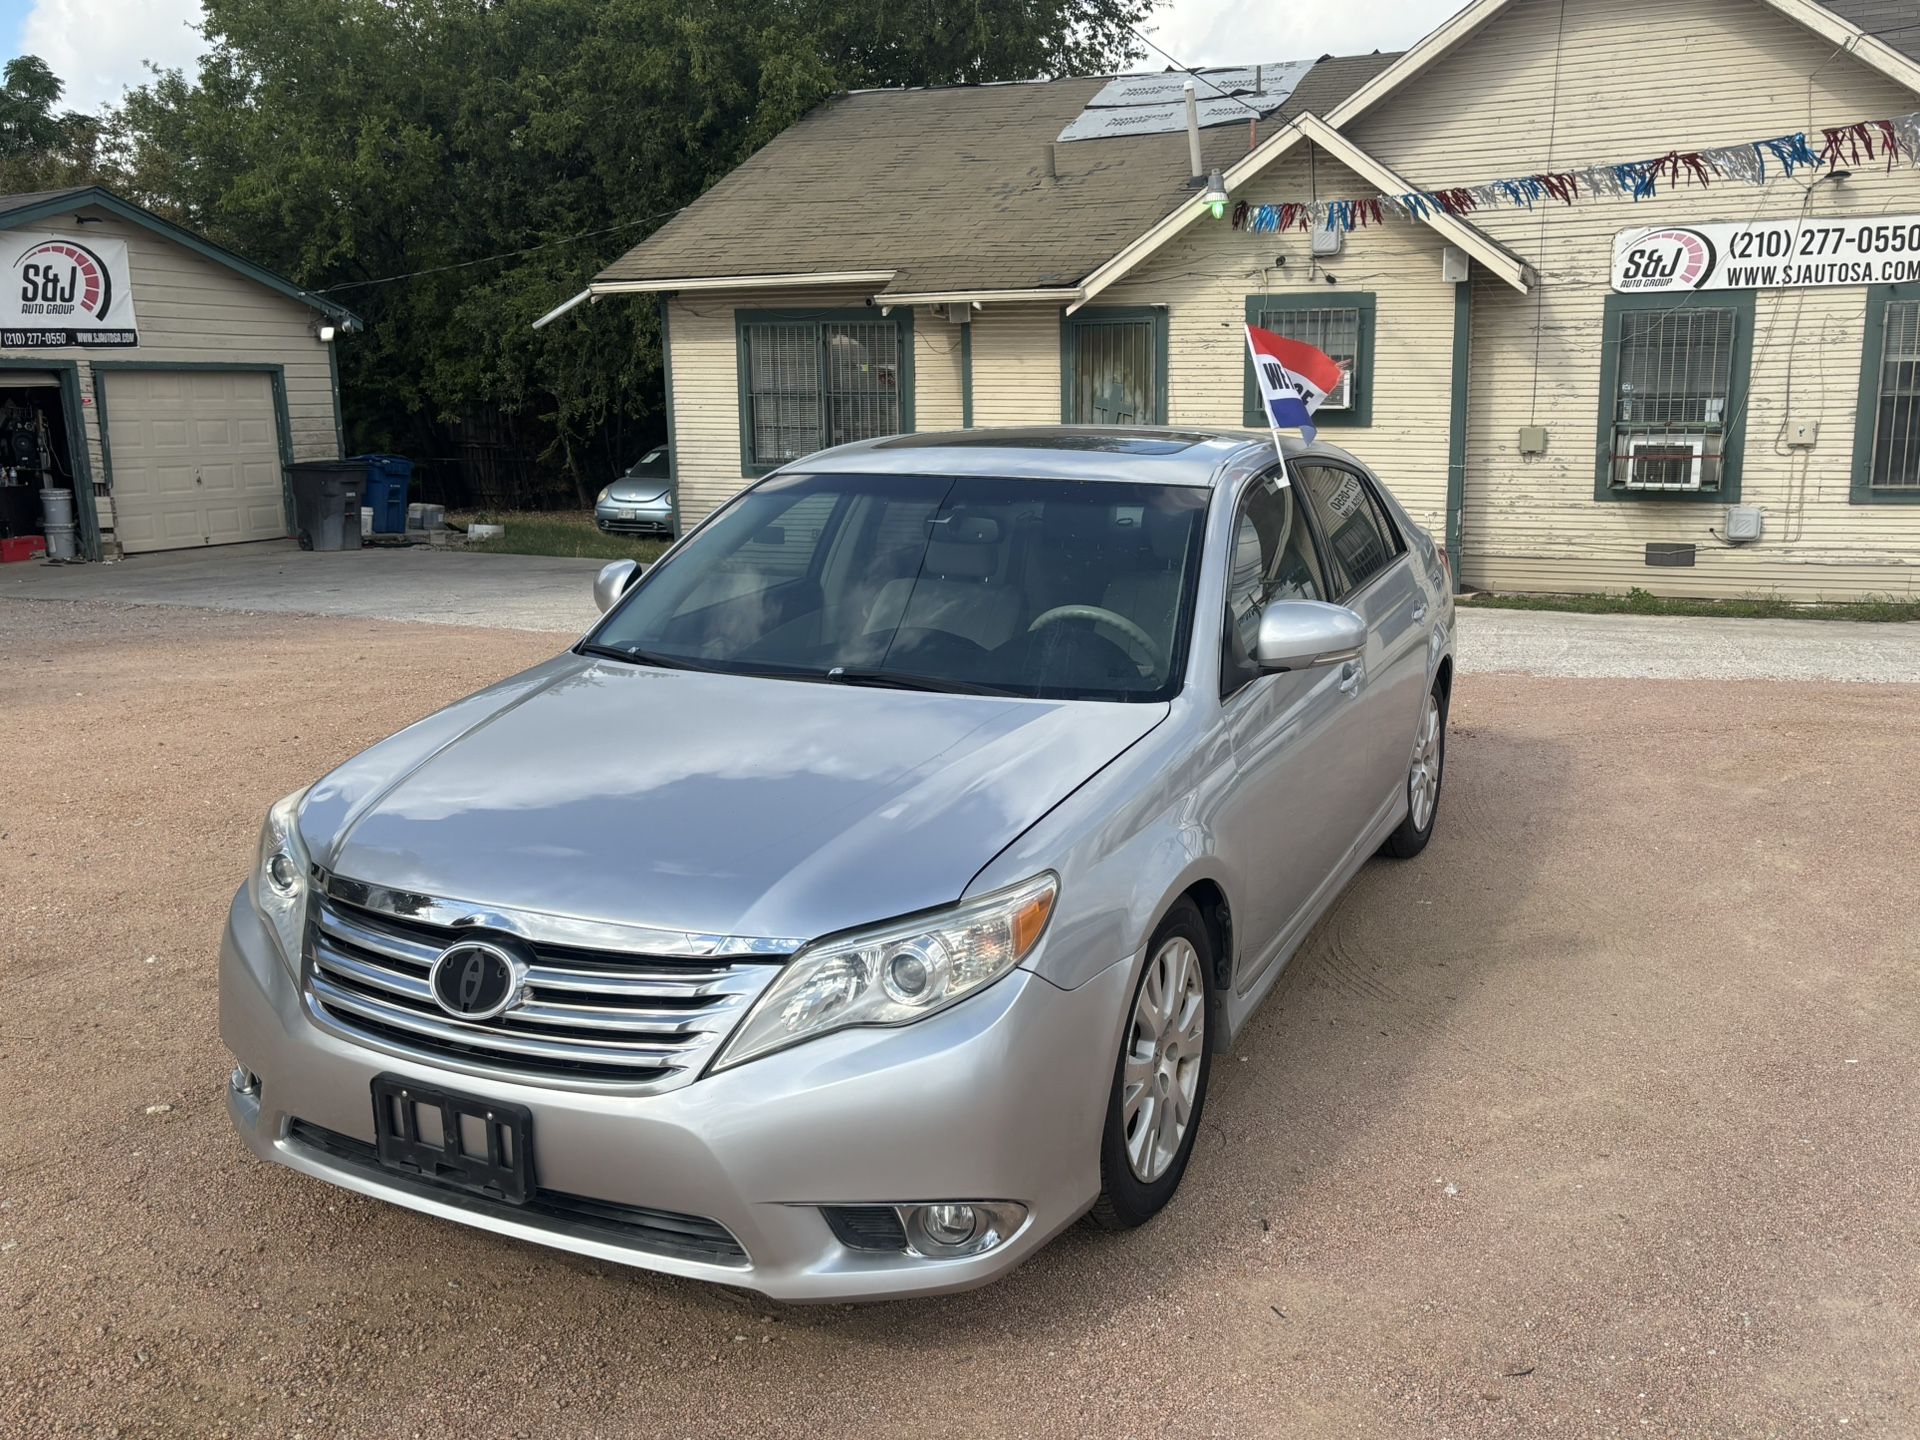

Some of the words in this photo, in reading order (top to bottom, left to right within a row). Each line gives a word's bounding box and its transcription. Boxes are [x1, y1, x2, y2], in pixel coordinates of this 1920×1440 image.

[1730, 229, 1791, 259] (210)
[1800, 224, 1920, 256] 277-0550
[1622, 247, 1683, 279] S&J
[1727, 260, 1920, 286] WWW.SJAUTOSA.COM
[21, 263, 77, 303] S&J
[1620, 280, 1642, 288] AUTO
[1643, 278, 1673, 287] GROUP
[21, 303, 44, 314] AUTO
[46, 304, 75, 315] GROUP
[4, 332, 26, 345] (210)
[27, 332, 67, 345] 277-0550
